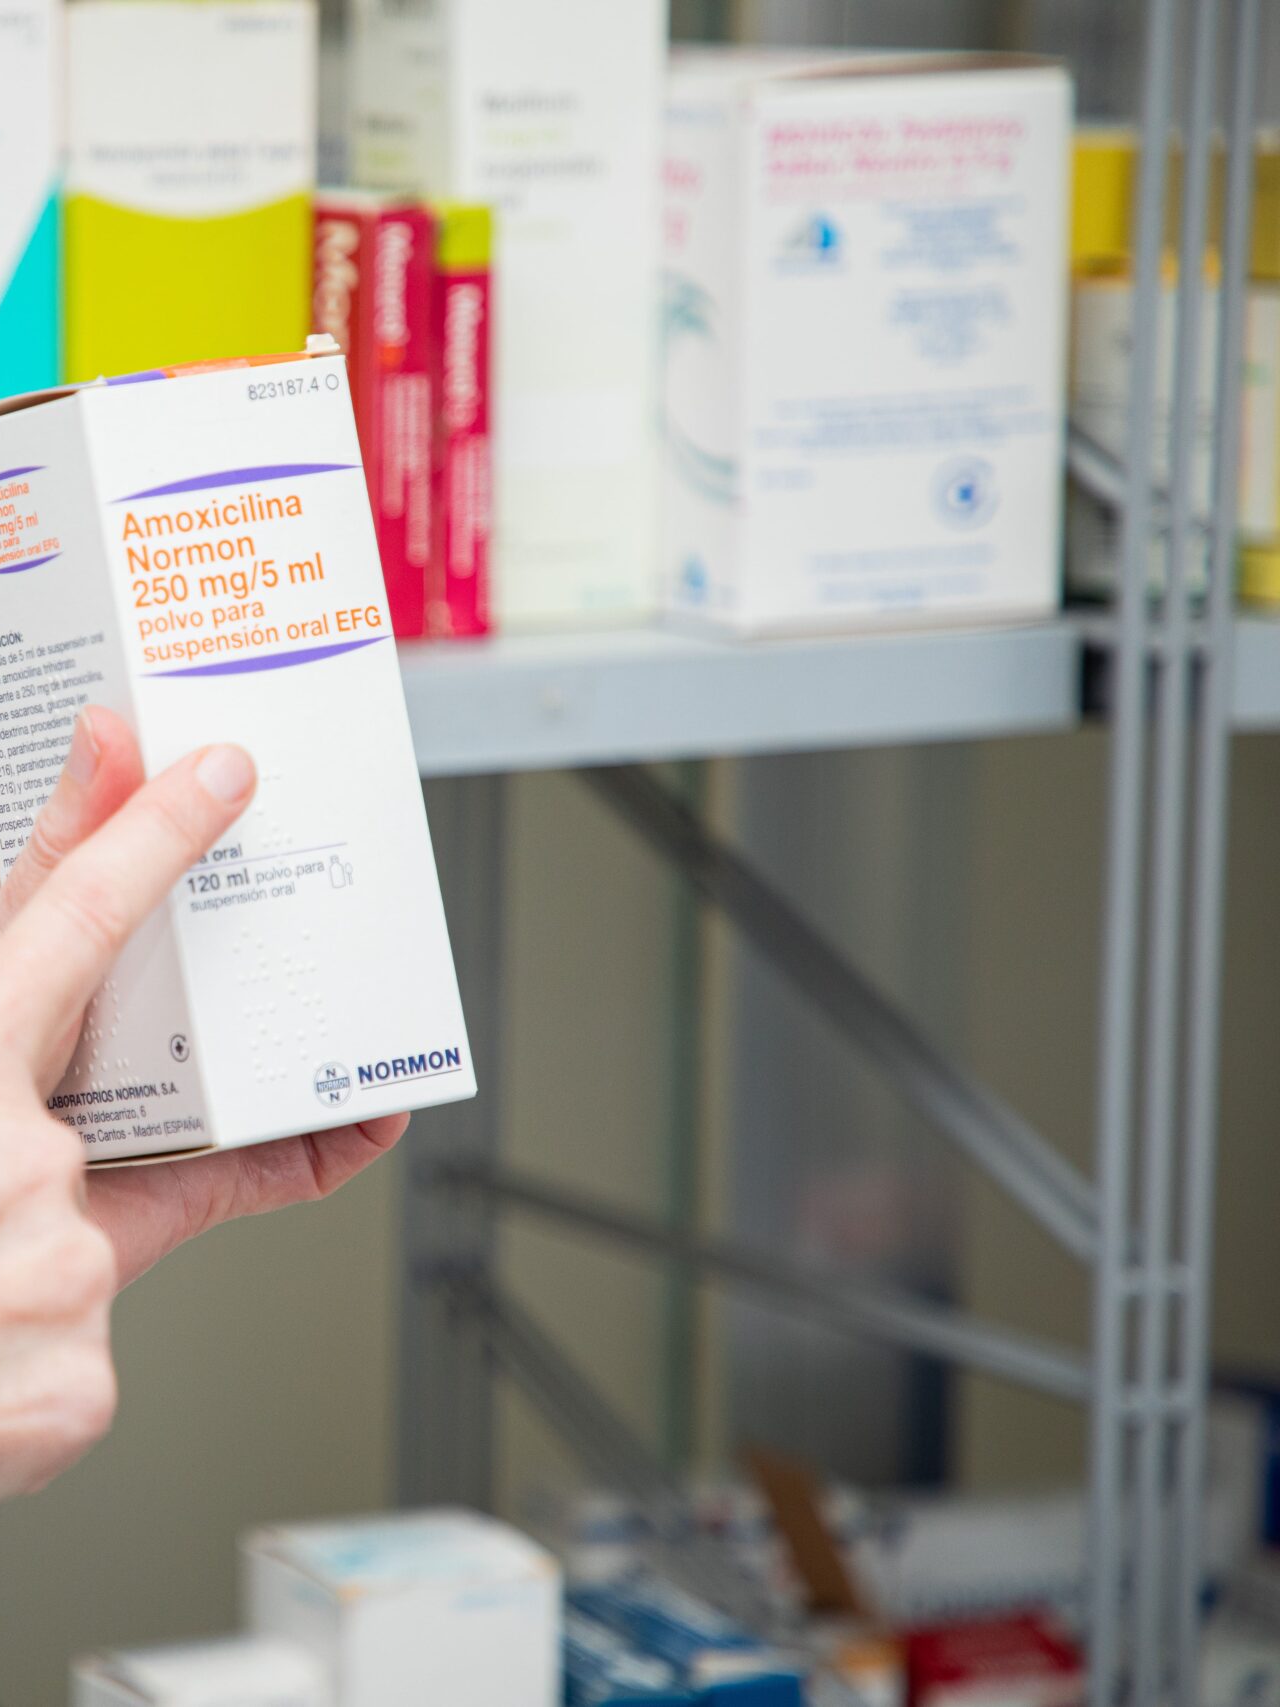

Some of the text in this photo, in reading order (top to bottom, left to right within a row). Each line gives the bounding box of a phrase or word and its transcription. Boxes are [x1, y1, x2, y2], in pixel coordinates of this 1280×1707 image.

[248, 376, 320, 401] 823187.4
[0, 514, 23, 535] mg/5
[26, 512, 38, 527] ml
[122, 493, 303, 541] Amoxicilina
[3, 537, 20, 548] para
[27, 544, 41, 555] oral
[43, 537, 60, 552] EFG
[126, 535, 256, 574] Normon
[132, 552, 325, 608] 250 mg/5 ml
[138, 601, 265, 640] polvo para
[143, 605, 382, 663] suspensión oral EFG
[8, 653, 18, 664] de
[19, 649, 24, 661] 5
[26, 646, 35, 659] ml
[36, 645, 46, 657] de
[47, 635, 88, 655] suspensión
[90, 630, 104, 645] oral
[2, 666, 42, 684] amoxicilina
[43, 659, 76, 674] trihidrato
[16, 690, 21, 700] a
[21, 684, 36, 698] 250
[37, 683, 50, 696] mg
[50, 680, 60, 691] de
[47, 696, 75, 714] glucosa
[30, 715, 72, 734] procedente
[7, 734, 73, 759] parahidroxibenzo
[16, 754, 68, 775] parahidroxibe
[17, 782, 22, 795] y
[24, 780, 43, 791] otros
[12, 798, 34, 812] mayor
[0, 838, 16, 850] Leer
[18, 835, 24, 847] el
[212, 844, 243, 862] oral
[187, 859, 325, 895] 120 ml polvo para
[190, 882, 296, 913] suspensión oral
[326, 1067, 337, 1080] N
[357, 1047, 462, 1084] NORMON
[47, 1082, 179, 1109] LABORATORIOS NORMON, S.A.
[330, 1091, 341, 1103] N
[77, 1112, 87, 1126] de
[78, 1131, 96, 1144] Tres
[97, 1128, 126, 1143] Cantos
[132, 1123, 162, 1139] Madrid
[164, 1115, 205, 1137] (ESPAÑA)
